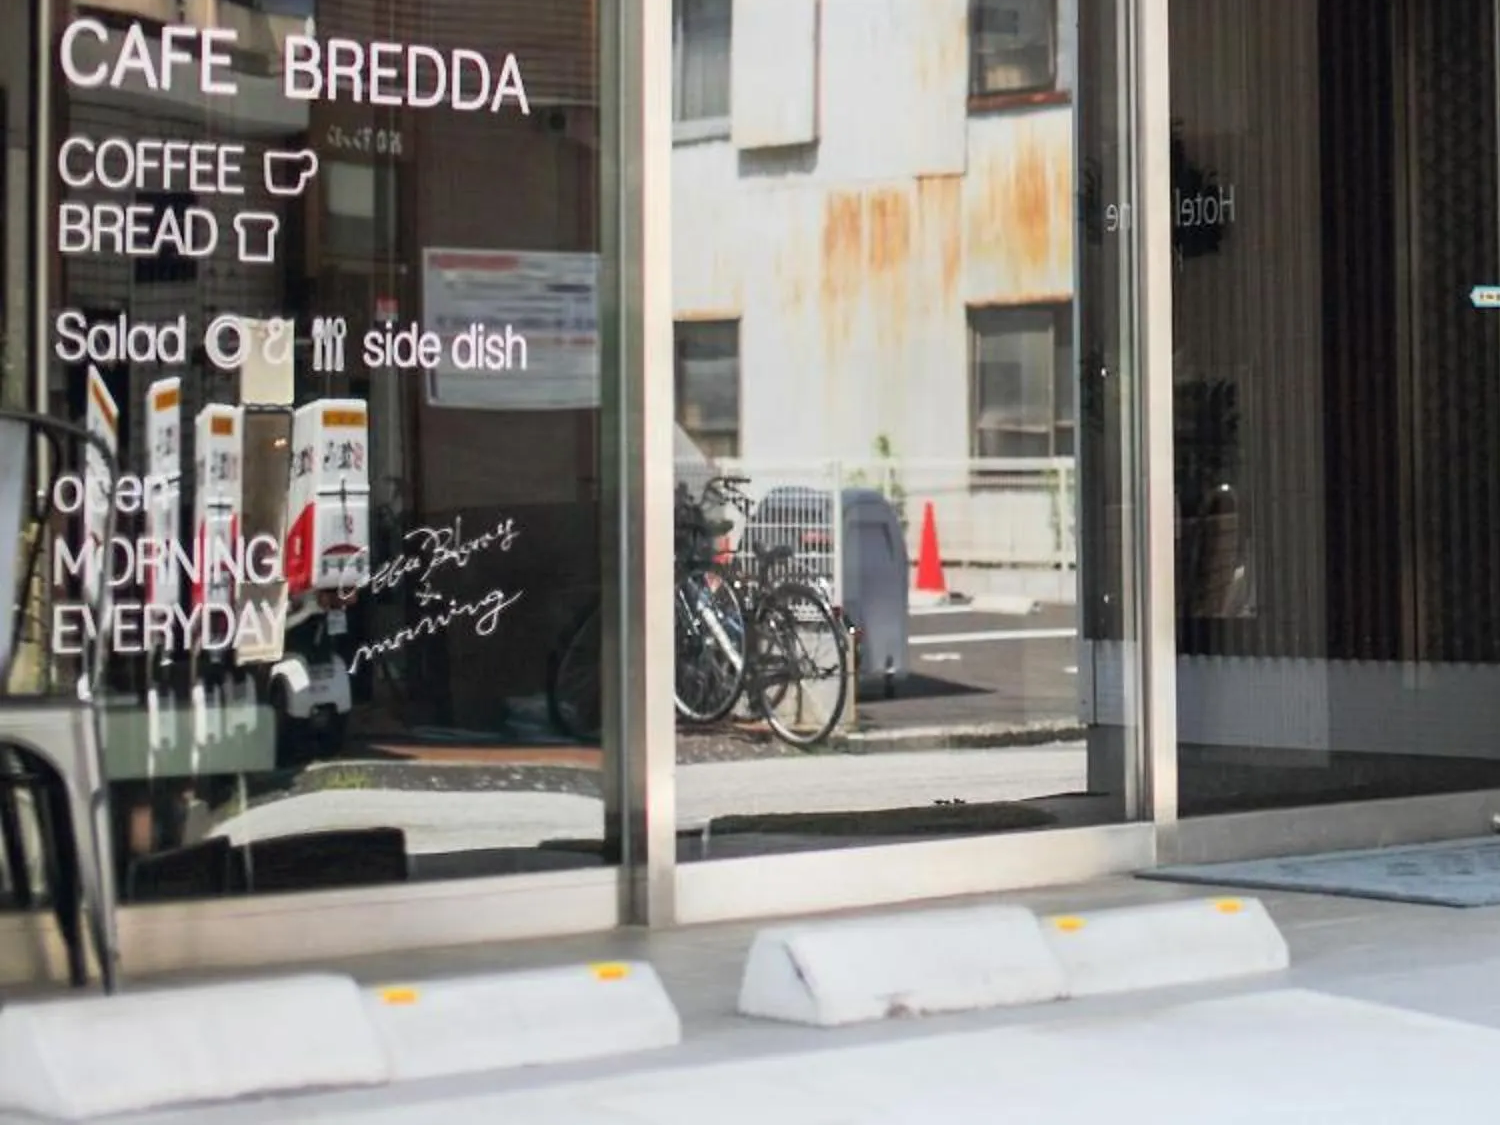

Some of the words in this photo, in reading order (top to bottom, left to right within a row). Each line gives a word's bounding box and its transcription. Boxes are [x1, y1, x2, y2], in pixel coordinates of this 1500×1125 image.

[61, 18, 237, 95] CAFE
[286, 35, 530, 115] BREDDA
[58, 137, 246, 194] COFFEE
[58, 204, 219, 257] BREAD
[55, 312, 187, 364] Salad
[363, 322, 442, 369] side
[451, 323, 528, 370] dish
[53, 475, 172, 525] oen
[53, 534, 281, 585] MORNING
[52, 601, 288, 654] EVERYDAY
